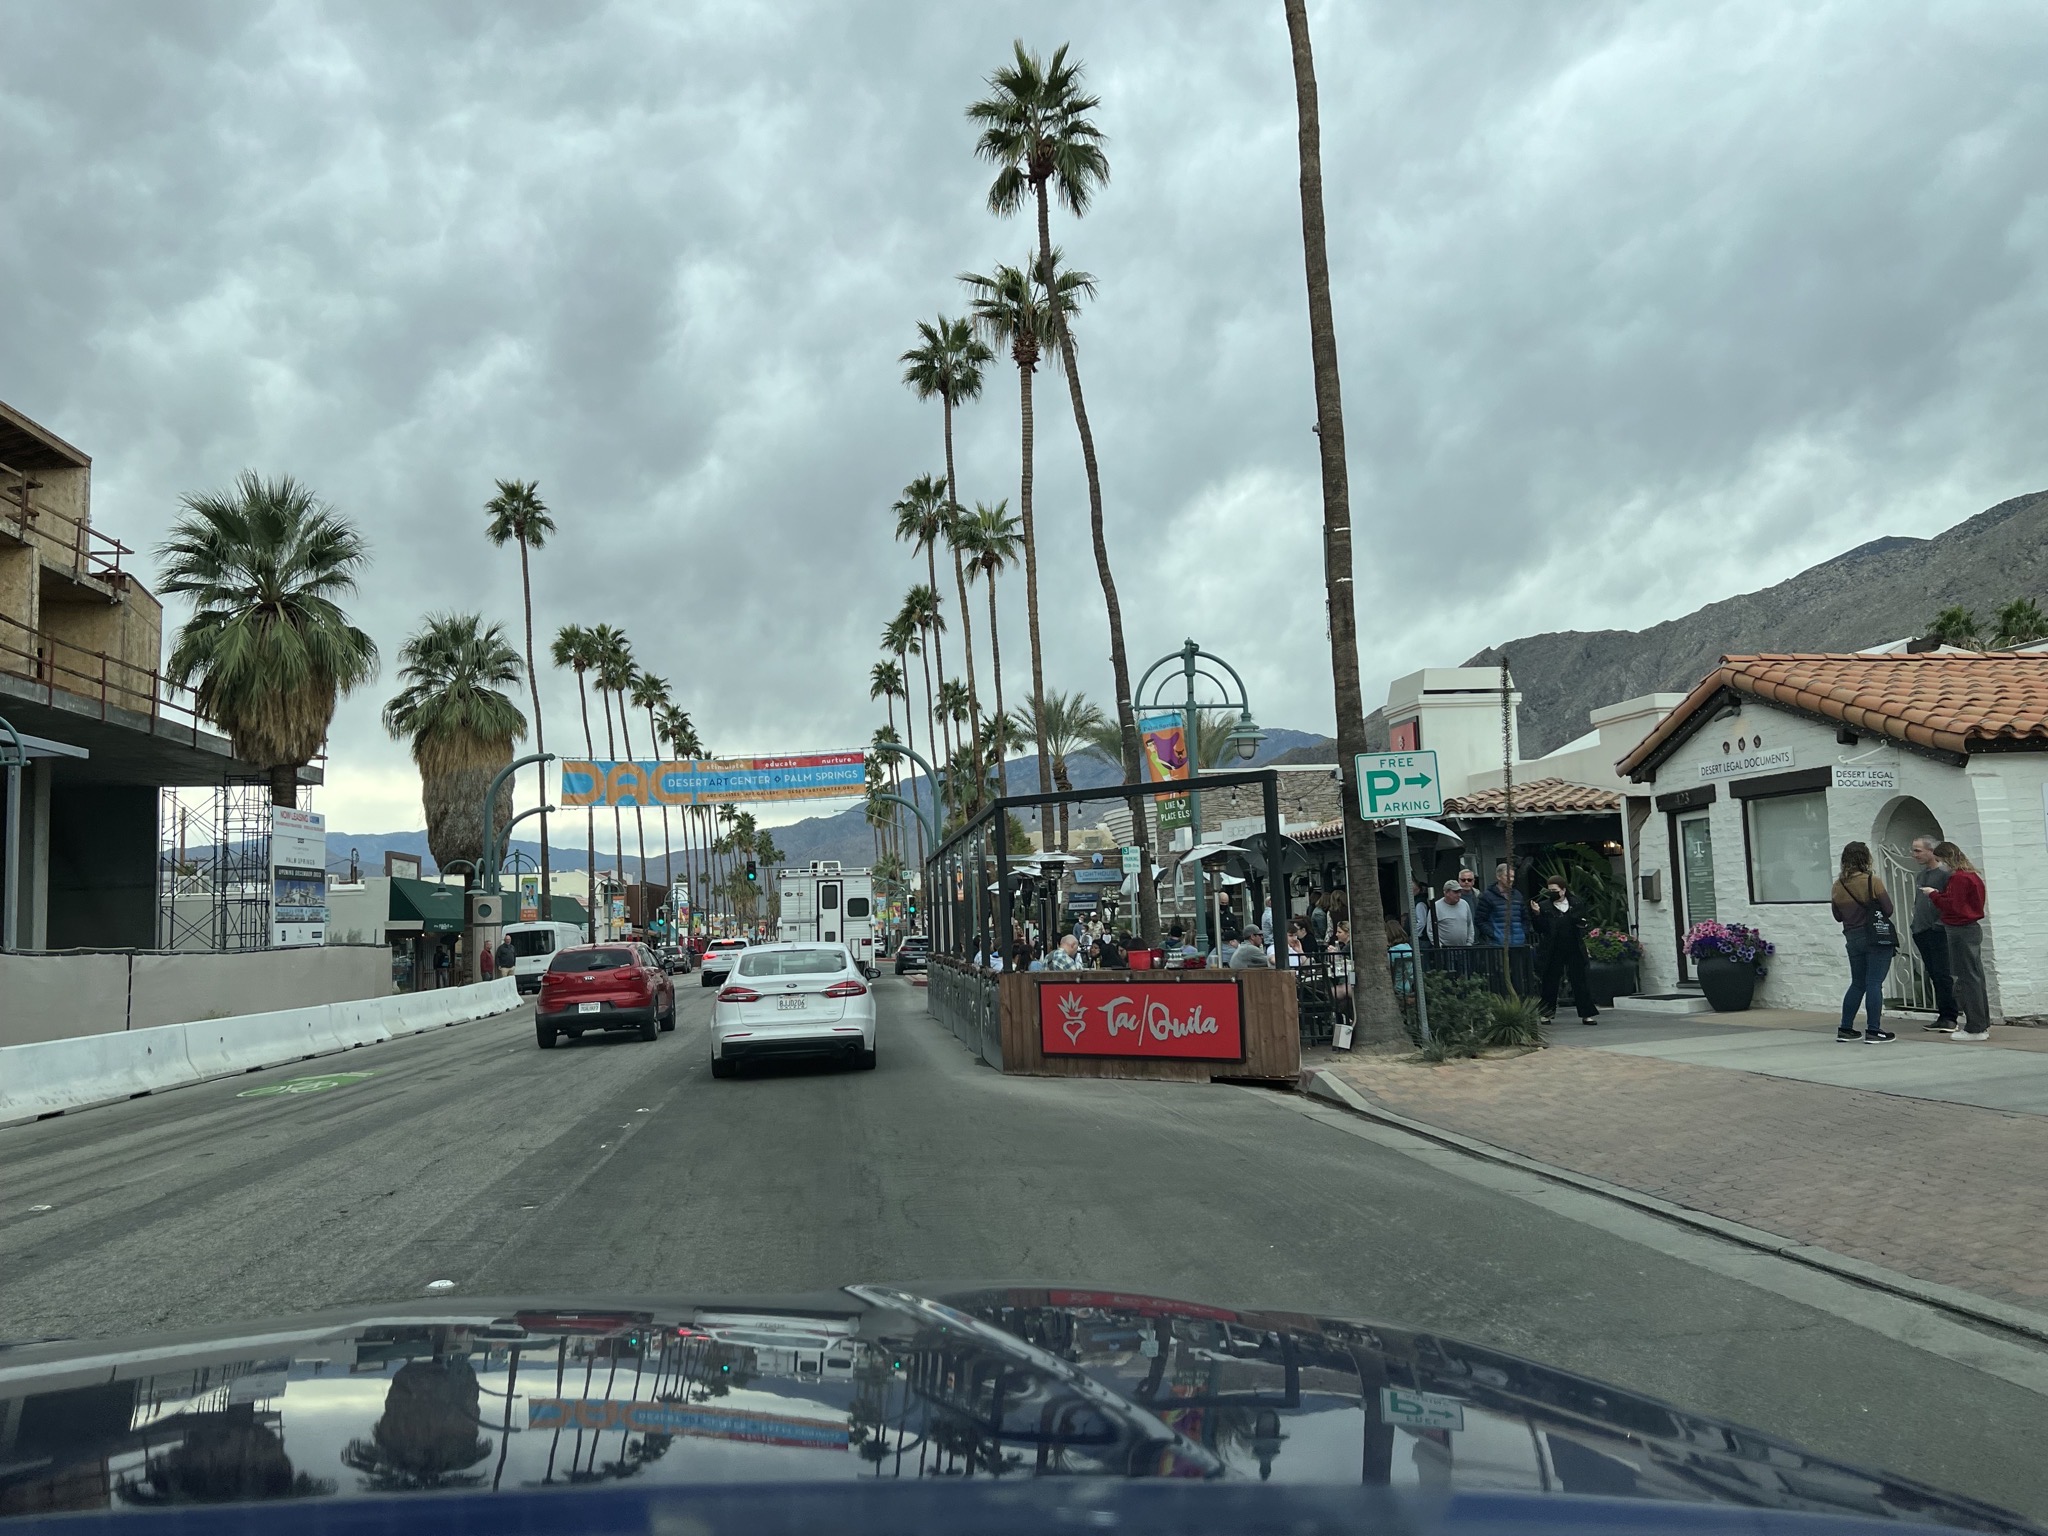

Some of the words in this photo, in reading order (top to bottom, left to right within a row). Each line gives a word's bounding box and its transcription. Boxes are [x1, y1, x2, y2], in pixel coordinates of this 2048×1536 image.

[764, 760, 797, 768] educate
[1379, 757, 1414, 768] FREE
[1701, 763, 1722, 776] DESERT
[1723, 760, 1743, 772] LEGAL
[1744, 752, 1790, 769] DOCUMENTS
[784, 773, 812, 783] PALM
[815, 770, 858, 781] SPRINGS
[1836, 770, 1866, 778] DESERT
[1868, 771, 1894, 779] LEGAL
[1837, 779, 1893, 788] DOCUMENTS
[1160, 811, 1177, 821] PLACE
[1177, 809, 1192, 819] ELS
